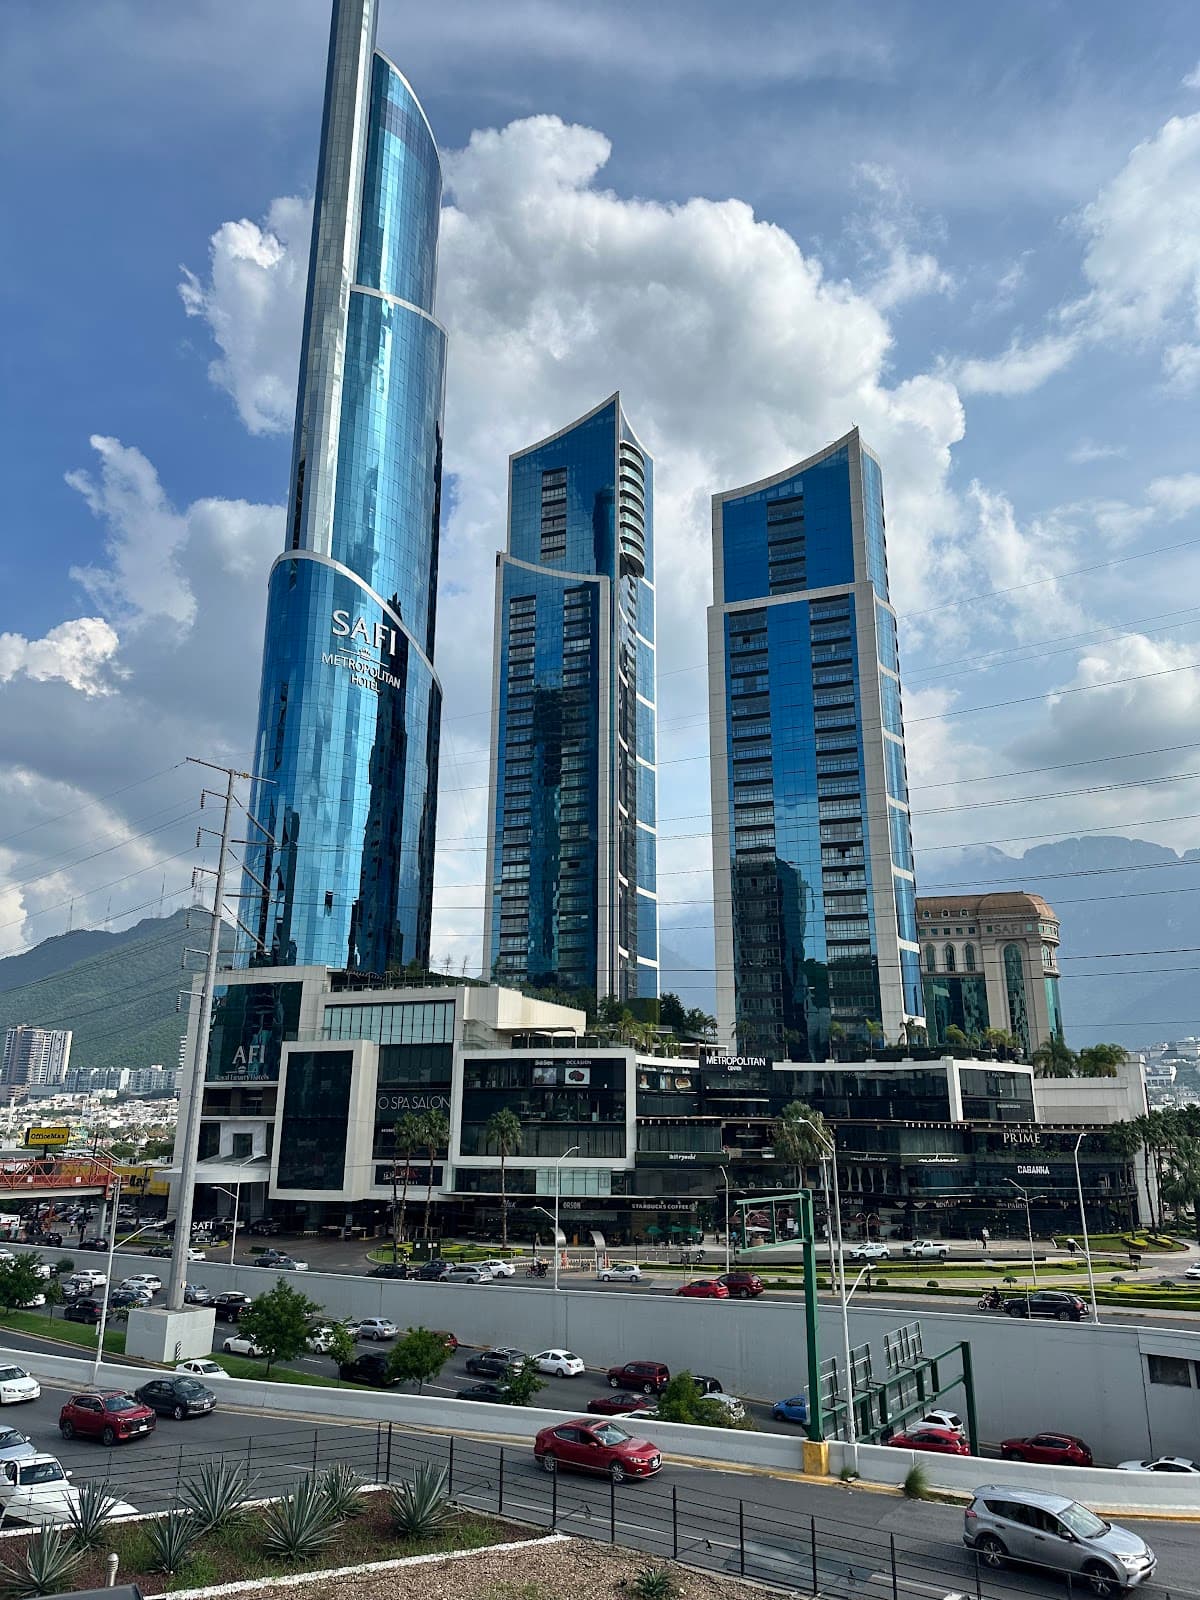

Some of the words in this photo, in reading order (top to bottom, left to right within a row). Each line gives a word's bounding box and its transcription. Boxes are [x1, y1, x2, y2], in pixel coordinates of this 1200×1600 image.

[332, 609, 397, 656] SAFI
[321, 652, 401, 689] METROPOLITAN
[351, 673, 380, 692] HOTEL
[994, 923, 1024, 935] SAFI
[706, 1056, 766, 1066] METROPOLITAN
[390, 1096, 410, 1110] SPA
[1003, 1132, 1041, 1144] PRIME
[1017, 1165, 1050, 1175] CABANNA
[191, 1221, 213, 1230] SAFI
